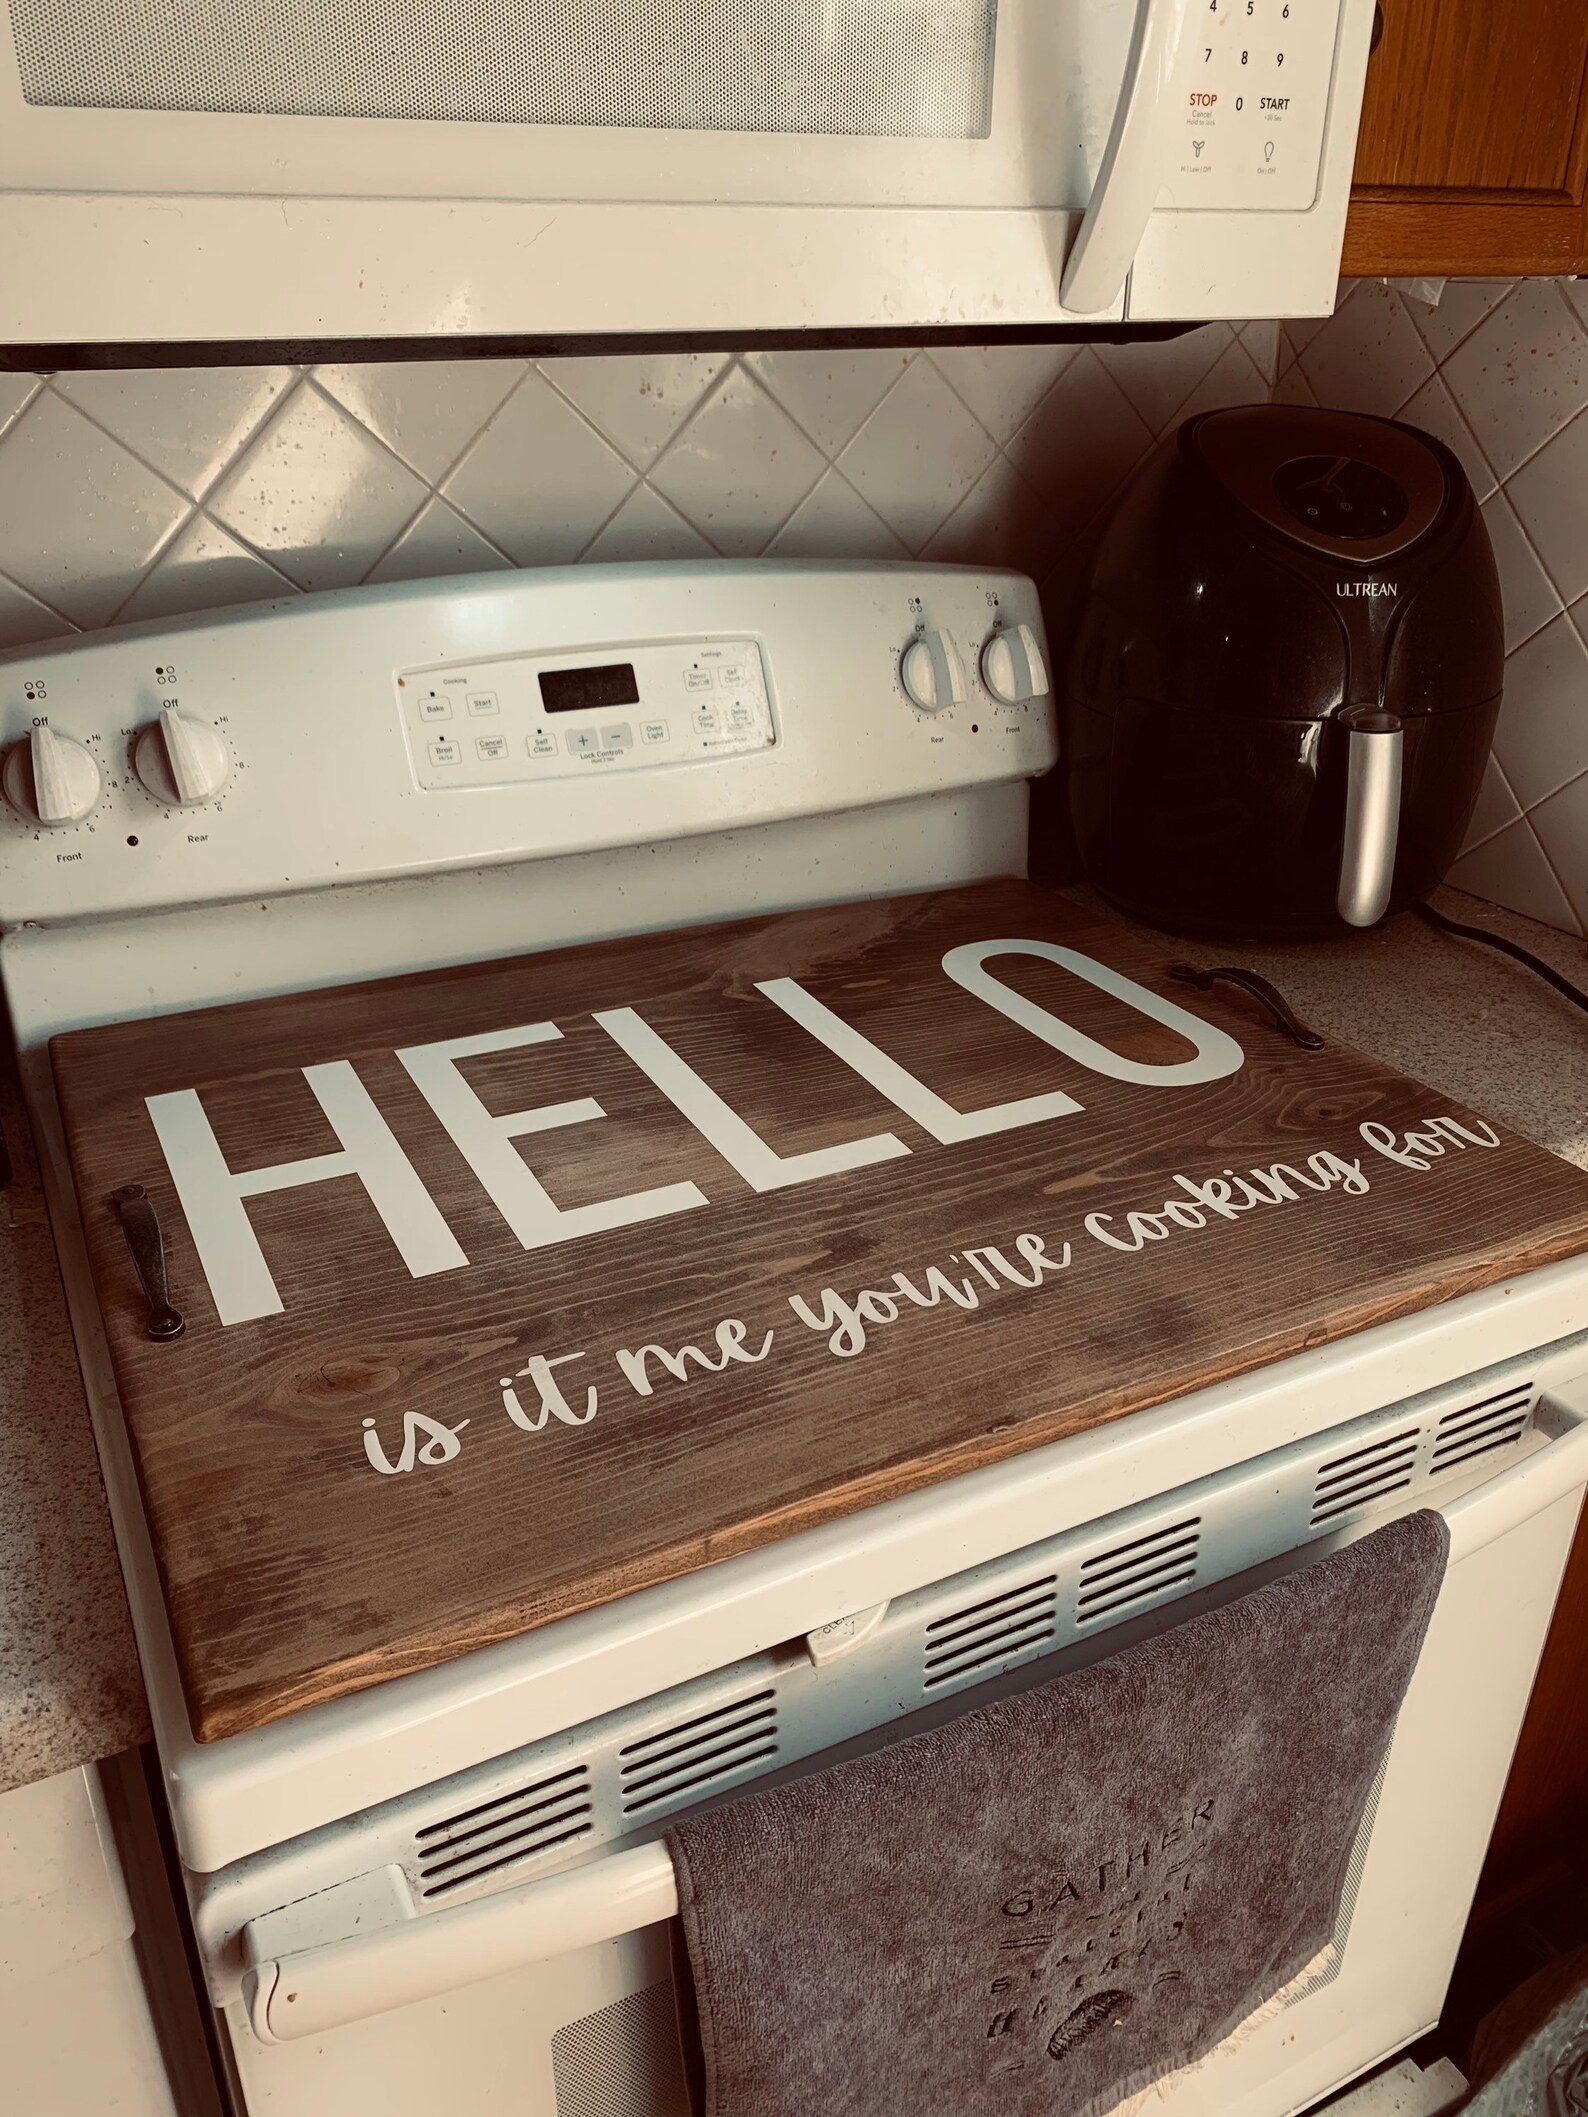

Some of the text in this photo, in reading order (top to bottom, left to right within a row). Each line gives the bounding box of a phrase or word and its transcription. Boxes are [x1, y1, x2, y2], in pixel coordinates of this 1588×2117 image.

[1209, 0, 1290, 18] 4 5 6
[1204, 49, 1284, 67] 7 8 9
[1189, 93, 1217, 106] STOP
[1235, 97, 1243, 111] 0
[1259, 97, 1290, 110] START
[1192, 110, 1212, 118] Cancel
[1336, 583, 1397, 597] ULTREAN
[443, 677, 467, 685] Cooking
[163, 699, 178, 708] Off
[473, 699, 492, 707] Start
[427, 705, 444, 713] Bake
[32, 717, 49, 727] Off
[121, 728, 131, 736] Lo
[647, 732, 664, 740] Light
[480, 740, 503, 748] Cancel
[436, 746, 453, 754] Broil
[487, 749, 498, 757] Off
[534, 746, 552, 754] Clean
[580, 752, 595, 760] Lock
[596, 749, 624, 758] Controls
[163, 812, 169, 820] 4
[187, 833, 209, 844] Rear
[56, 852, 83, 863] Front
[144, 938, 1244, 1327] HELLO
[361, 1116, 1501, 1475] is it me you're cooking for
[1001, 1799, 1214, 1917] GATHER
